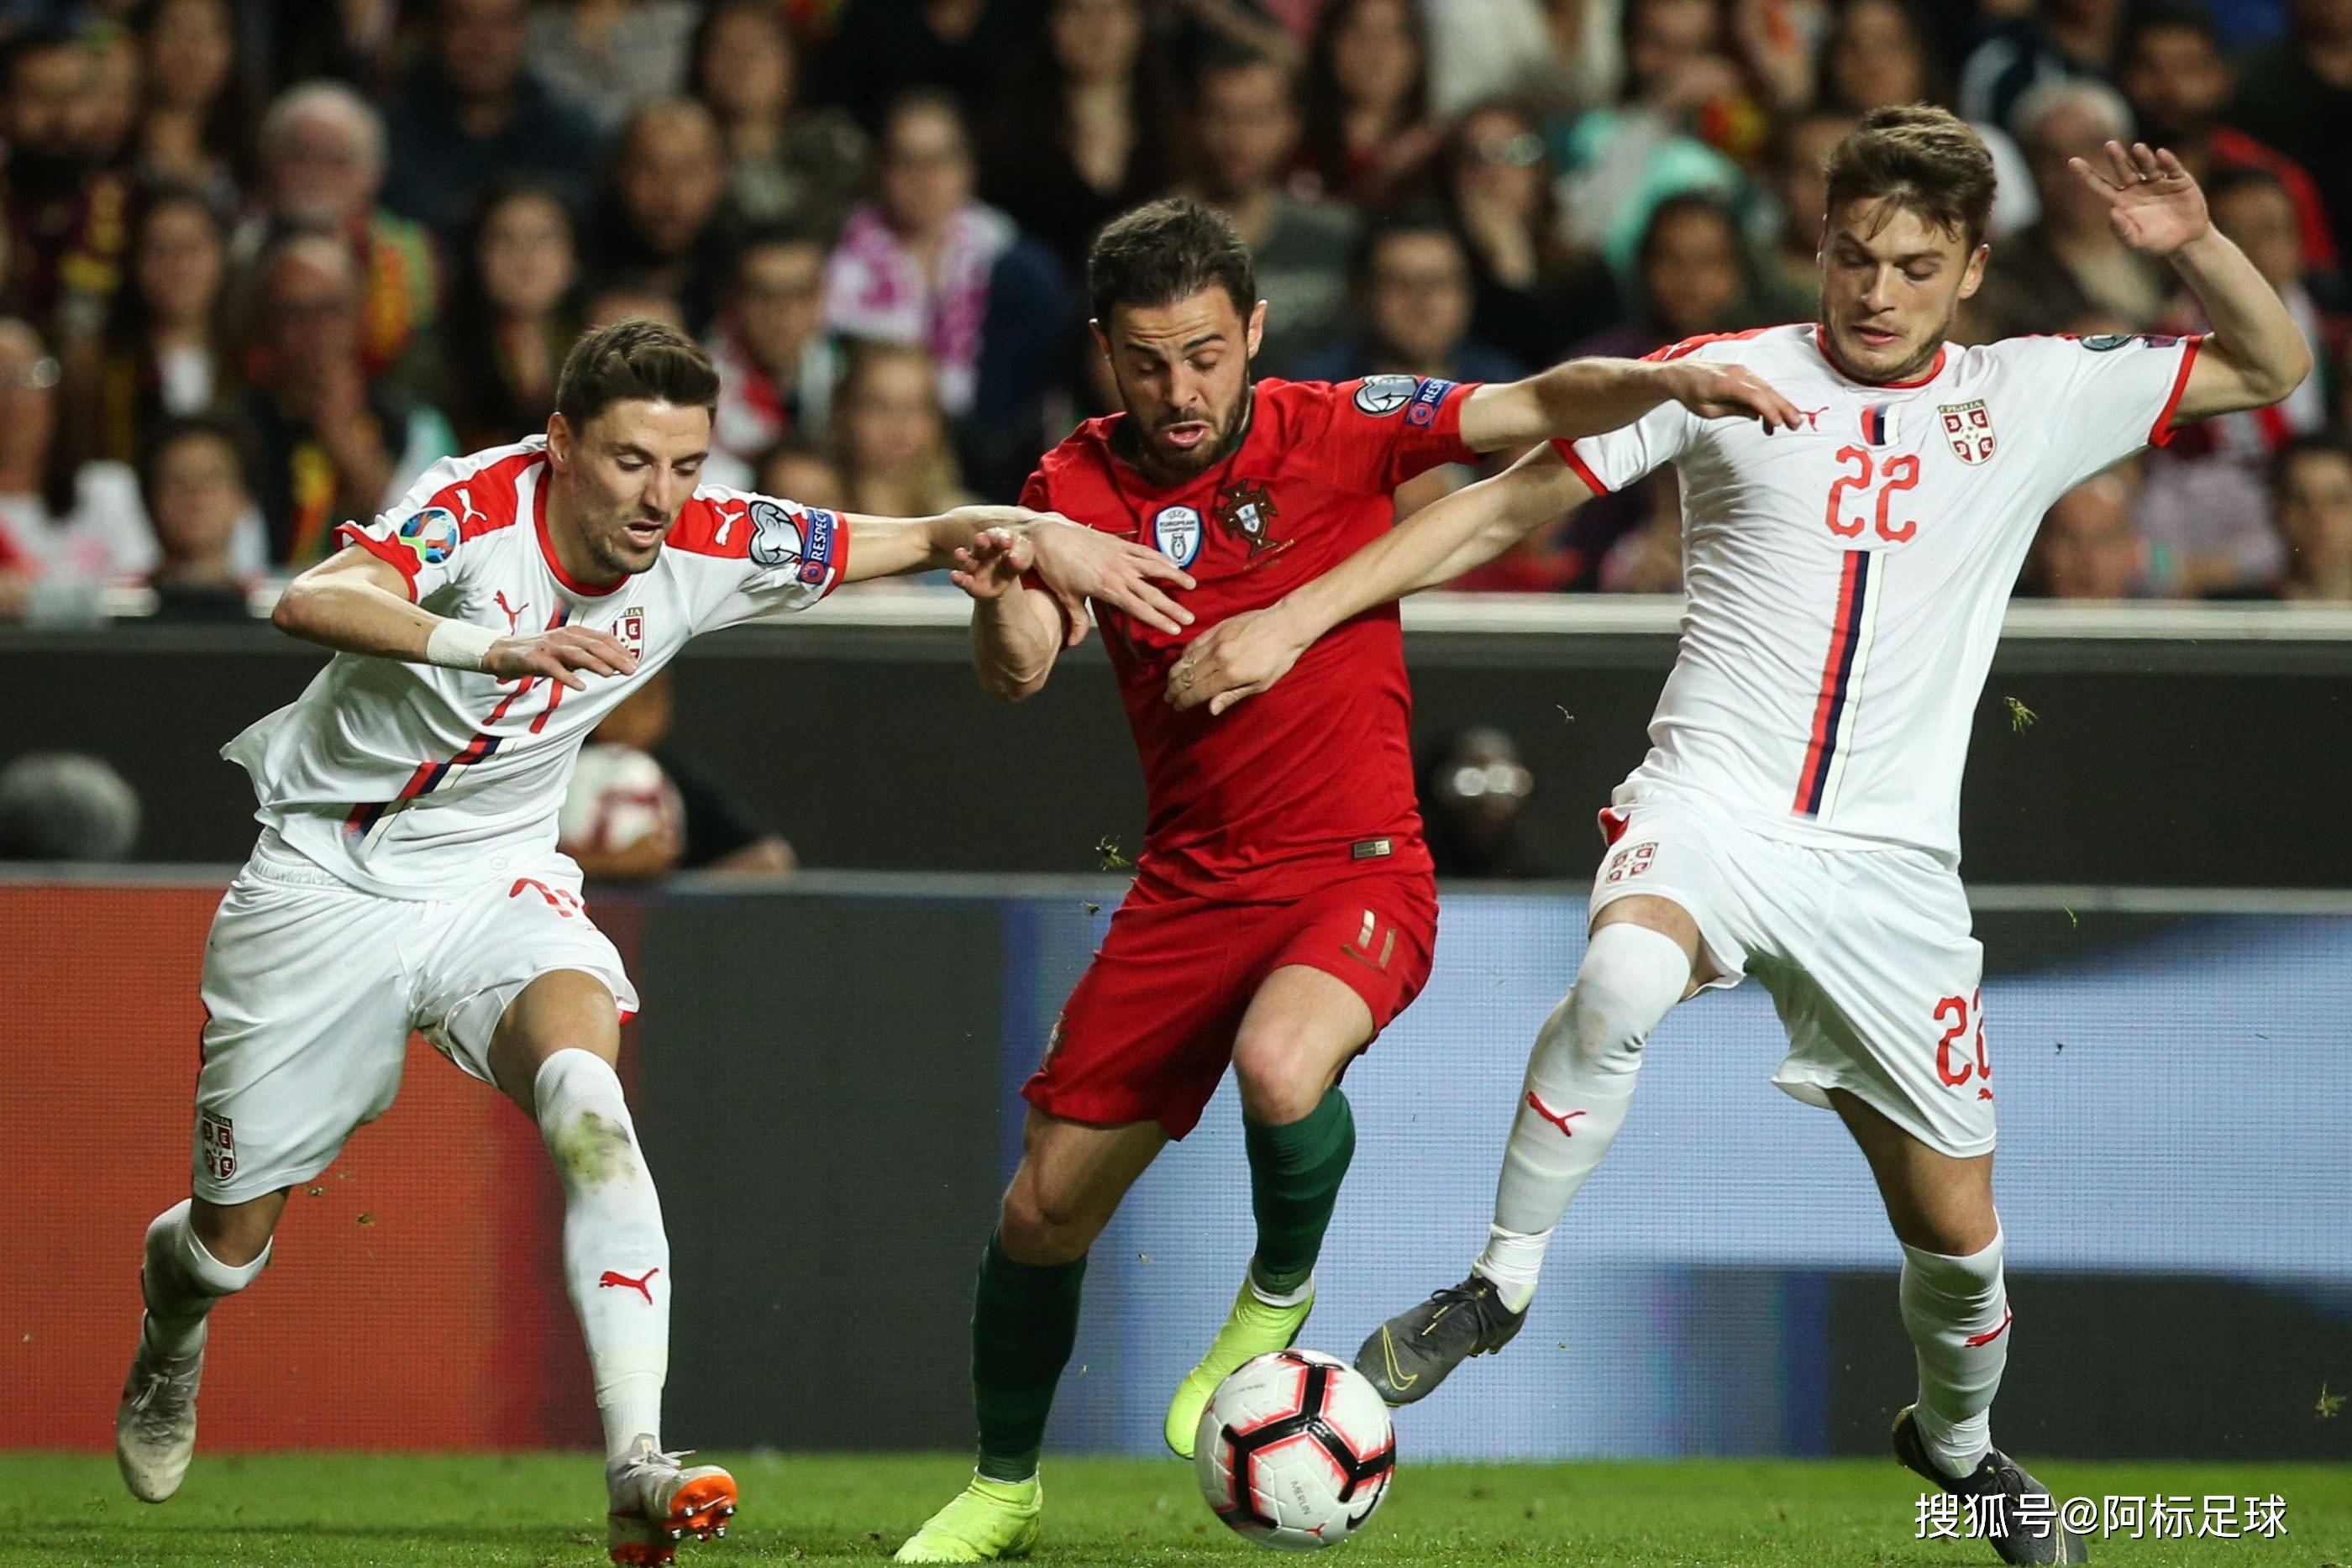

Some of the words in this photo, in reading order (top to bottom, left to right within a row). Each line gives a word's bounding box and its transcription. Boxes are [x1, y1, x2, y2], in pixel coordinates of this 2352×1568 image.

[1825, 444, 1919, 543] 22
[1159, 519, 1196, 527] EUROPEAN
[1159, 526, 1196, 534] CHAMPIONS
[1289, 1480, 1312, 1515] MERLIN
